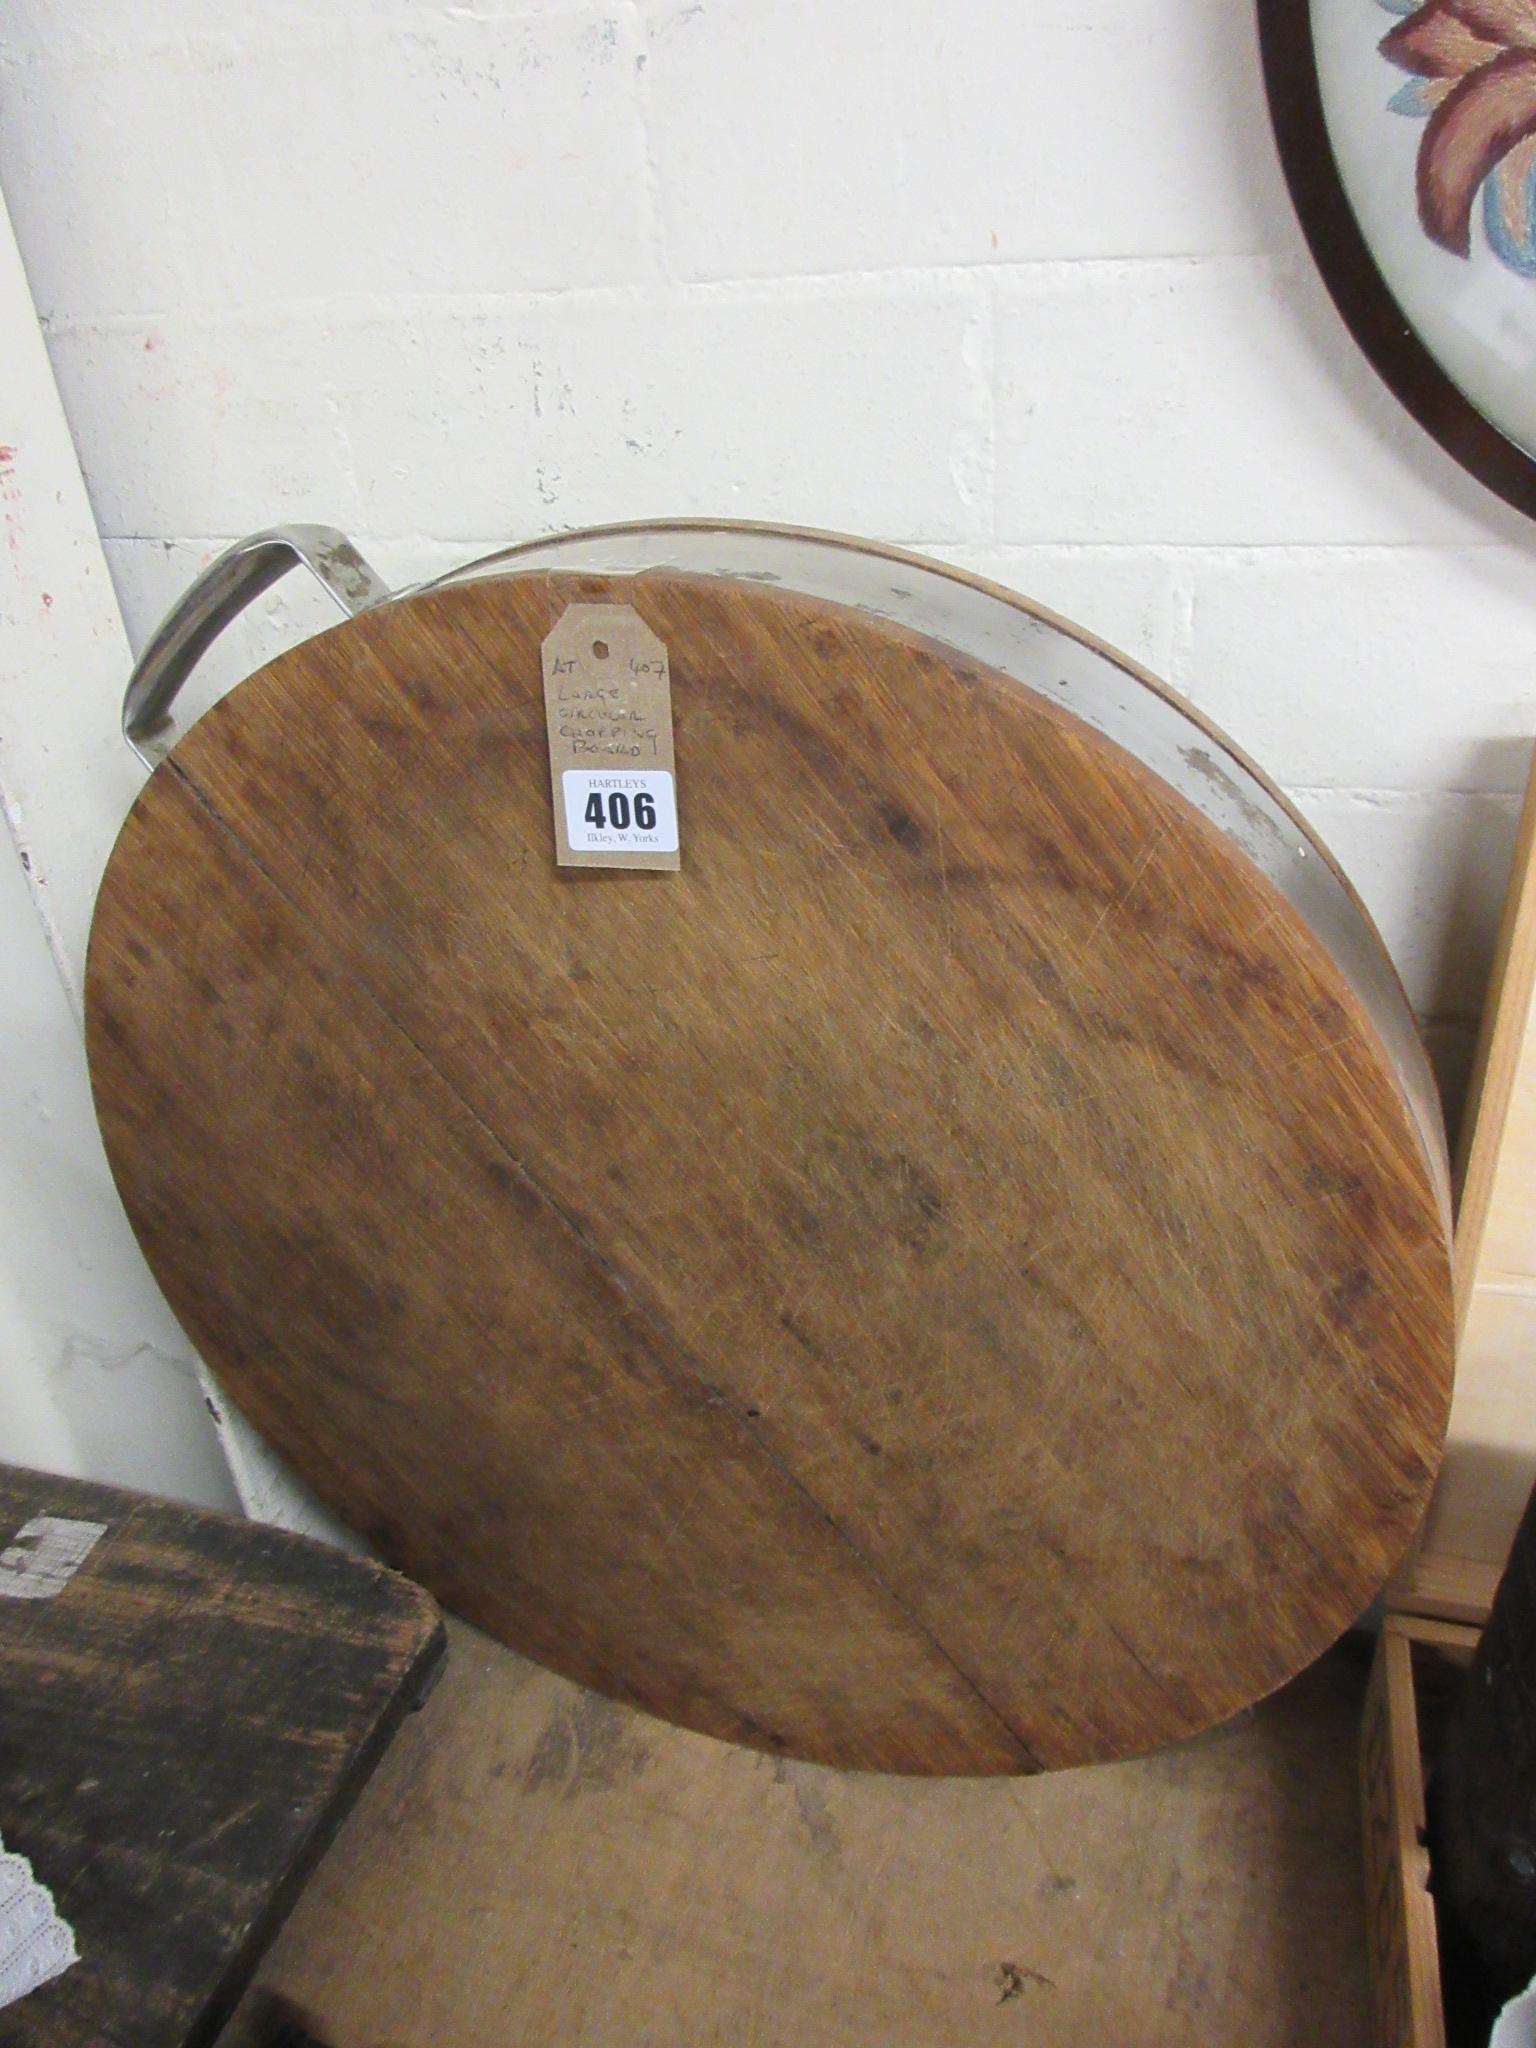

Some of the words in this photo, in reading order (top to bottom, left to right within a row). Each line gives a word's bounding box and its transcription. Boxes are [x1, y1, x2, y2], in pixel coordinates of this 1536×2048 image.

[629, 658, 666, 680] 407
[558, 685, 620, 705] LARGE
[559, 707, 646, 722] CIRCULAR
[559, 725, 657, 755] CHOPPING
[572, 739, 641, 757] BOARD
[588, 778, 647, 789] HARTLEYS
[584, 792, 657, 831] 406
[632, 833, 659, 844] Yorks
